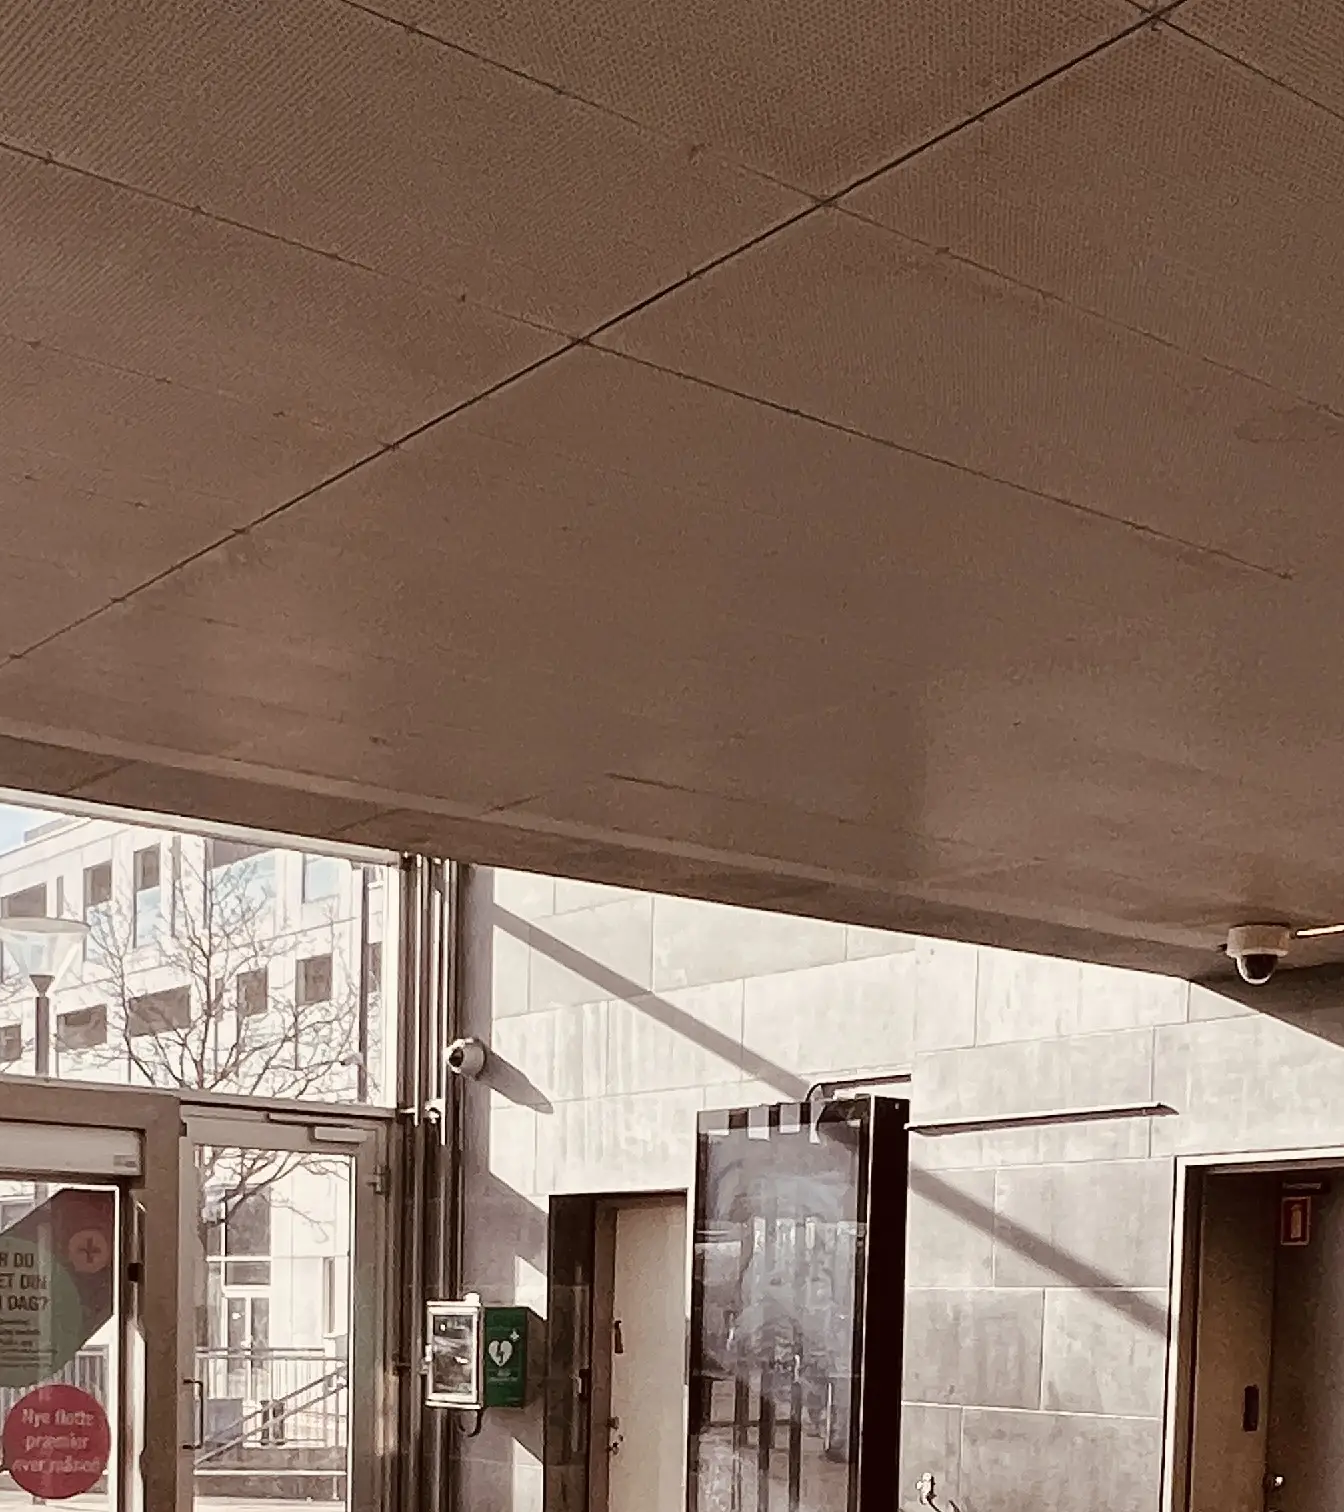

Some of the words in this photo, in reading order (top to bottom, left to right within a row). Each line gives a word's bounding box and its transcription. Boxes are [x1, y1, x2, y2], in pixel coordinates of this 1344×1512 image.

[14, 1253, 34, 1268] DU
[20, 1274, 47, 1290] DIN
[7, 1296, 49, 1312] DAG?
[21, 1408, 52, 1428] Nye
